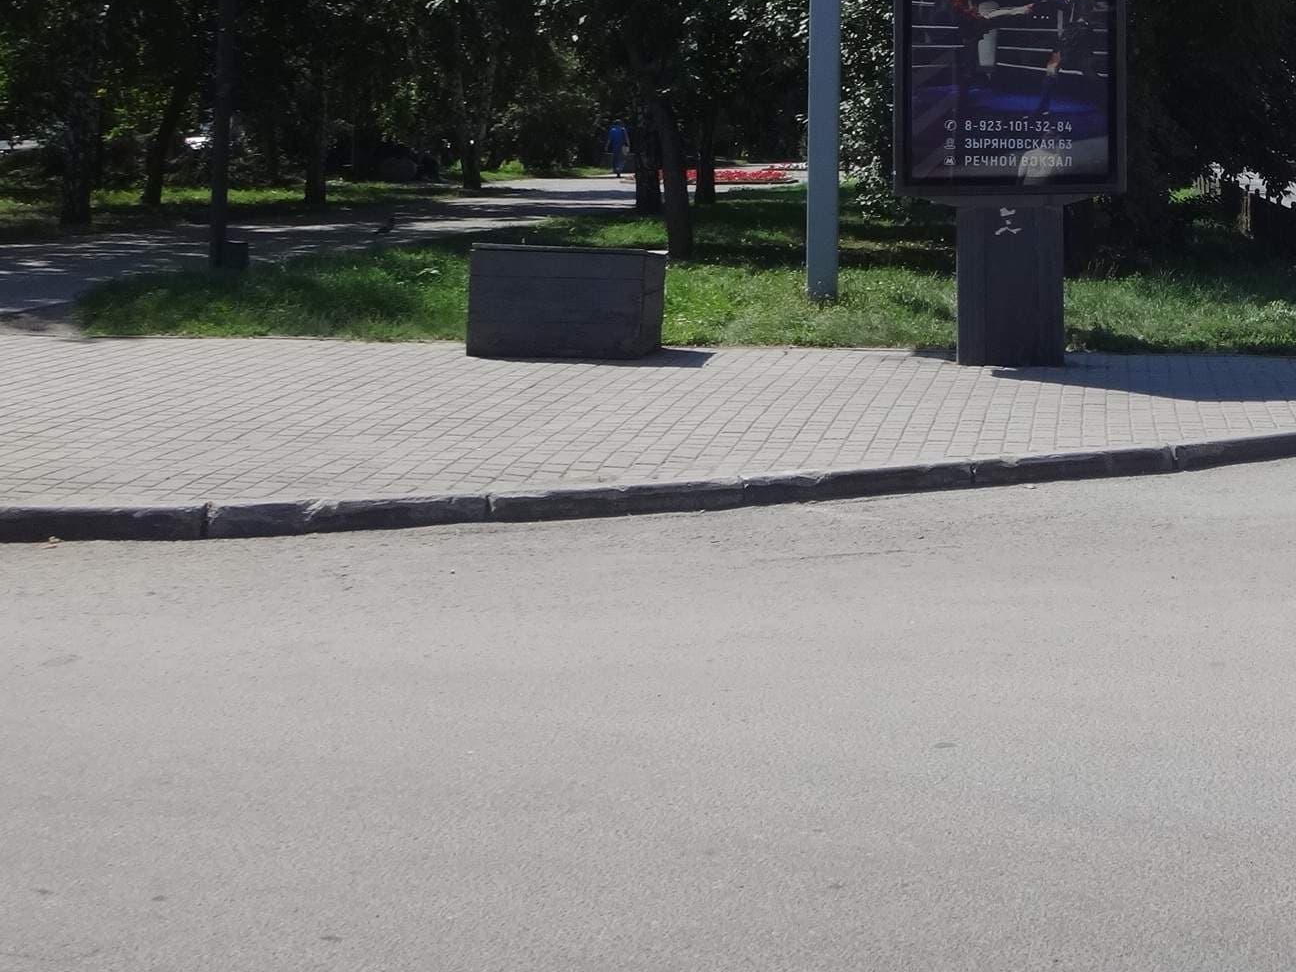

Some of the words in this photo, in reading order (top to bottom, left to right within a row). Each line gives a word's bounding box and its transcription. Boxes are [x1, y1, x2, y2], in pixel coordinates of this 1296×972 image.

[964, 120, 1073, 132] 8-923-101-32-84
[964, 138, 1055, 149] ЗЫРЯНОВСКАЯ
[1058, 139, 1073, 149] 63
[964, 154, 1017, 167] РЕЧНОЙ
[1021, 156, 1073, 167] ВОКЗАЛ
